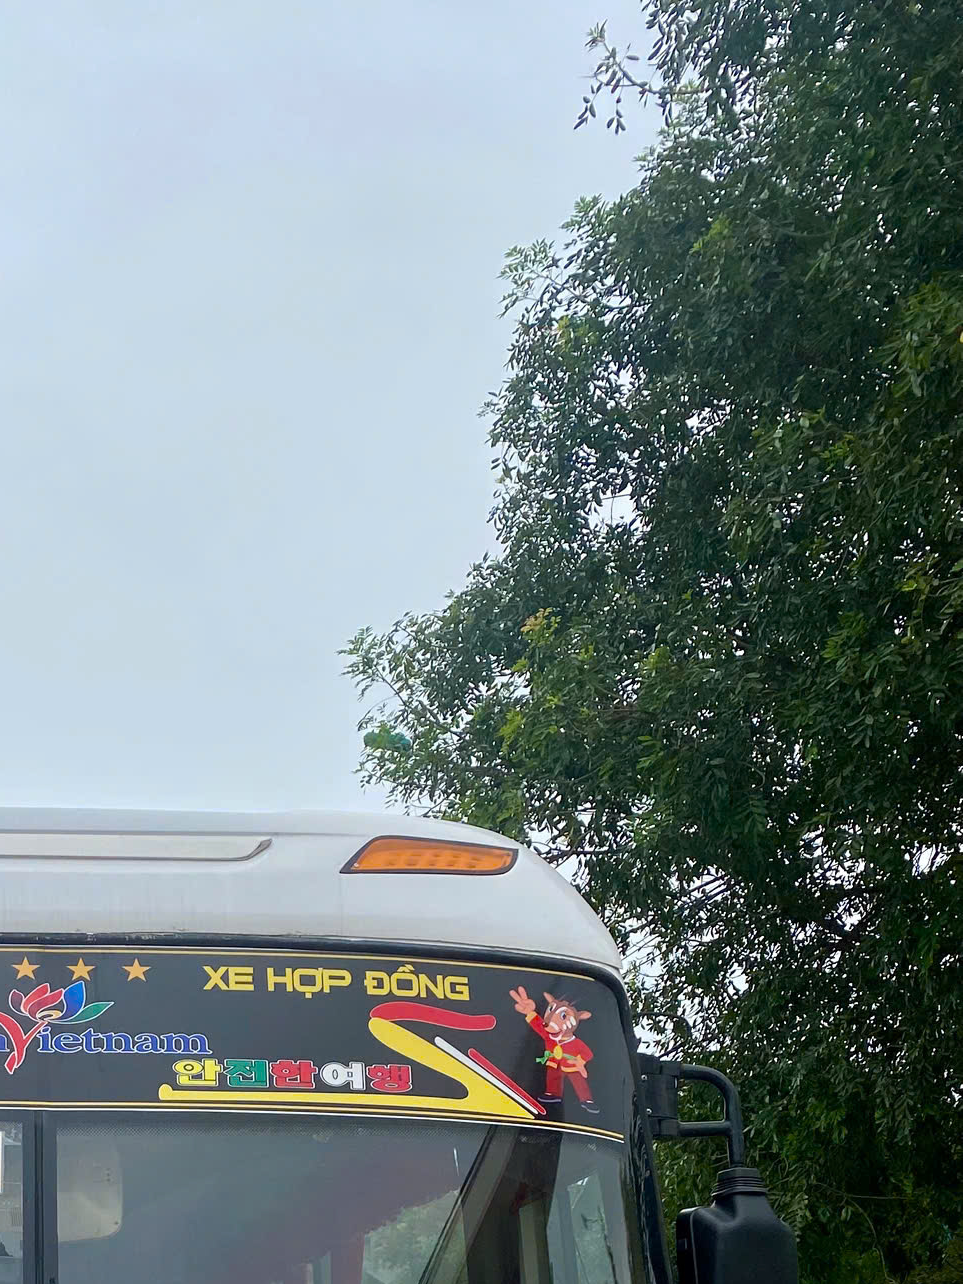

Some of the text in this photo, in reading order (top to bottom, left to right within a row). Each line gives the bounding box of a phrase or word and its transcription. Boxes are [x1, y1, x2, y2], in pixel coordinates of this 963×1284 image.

[203, 964, 470, 1000] XE HỢP ĐỒNG
[172, 1058, 413, 1093] 안전한여행
